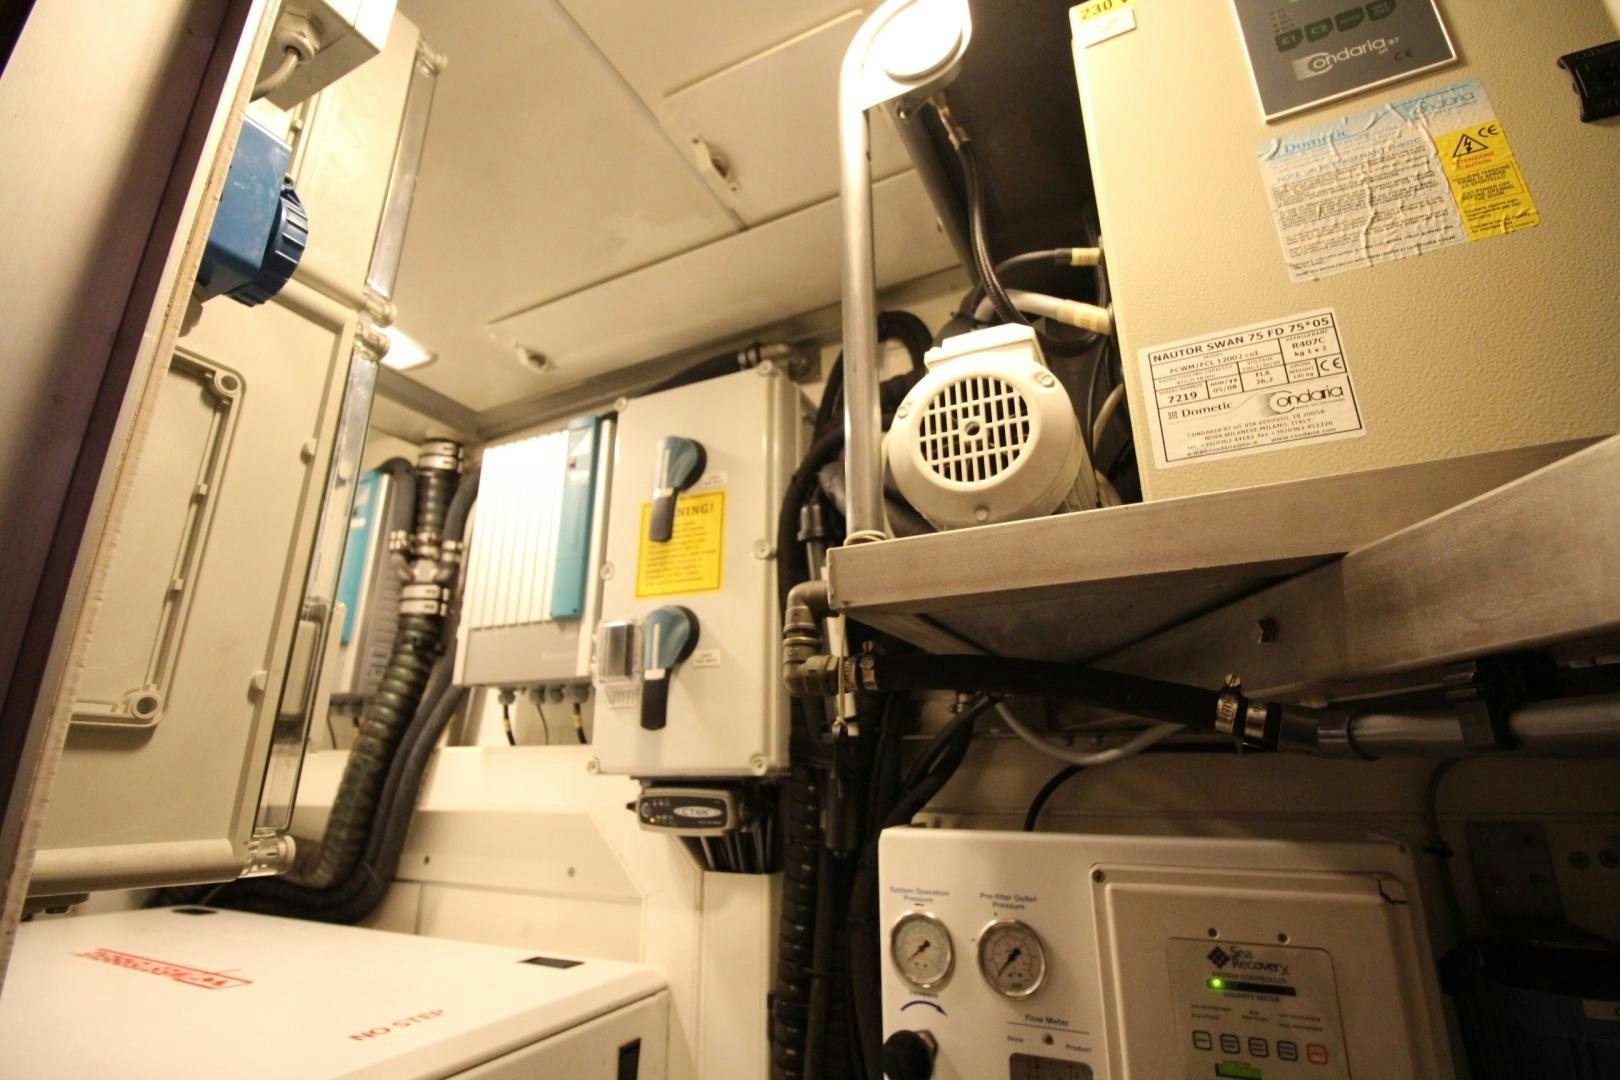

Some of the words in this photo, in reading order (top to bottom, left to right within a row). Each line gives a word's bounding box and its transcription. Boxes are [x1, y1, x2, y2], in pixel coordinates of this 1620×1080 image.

[1081, 0, 1113, 20] 230
[1153, 345, 1202, 362] NAUTOR
[1206, 336, 1244, 350] SWAN
[1248, 331, 1263, 341] 75
[1267, 327, 1284, 337] FD
[1169, 391, 1197, 403] 7219
[1269, 386, 1344, 413] Condaria
[1181, 401, 1231, 417] Dometic
[1229, 945, 1253, 960] Sea
[349, 1027, 391, 1041] NO
[392, 1010, 444, 1026] STEP
